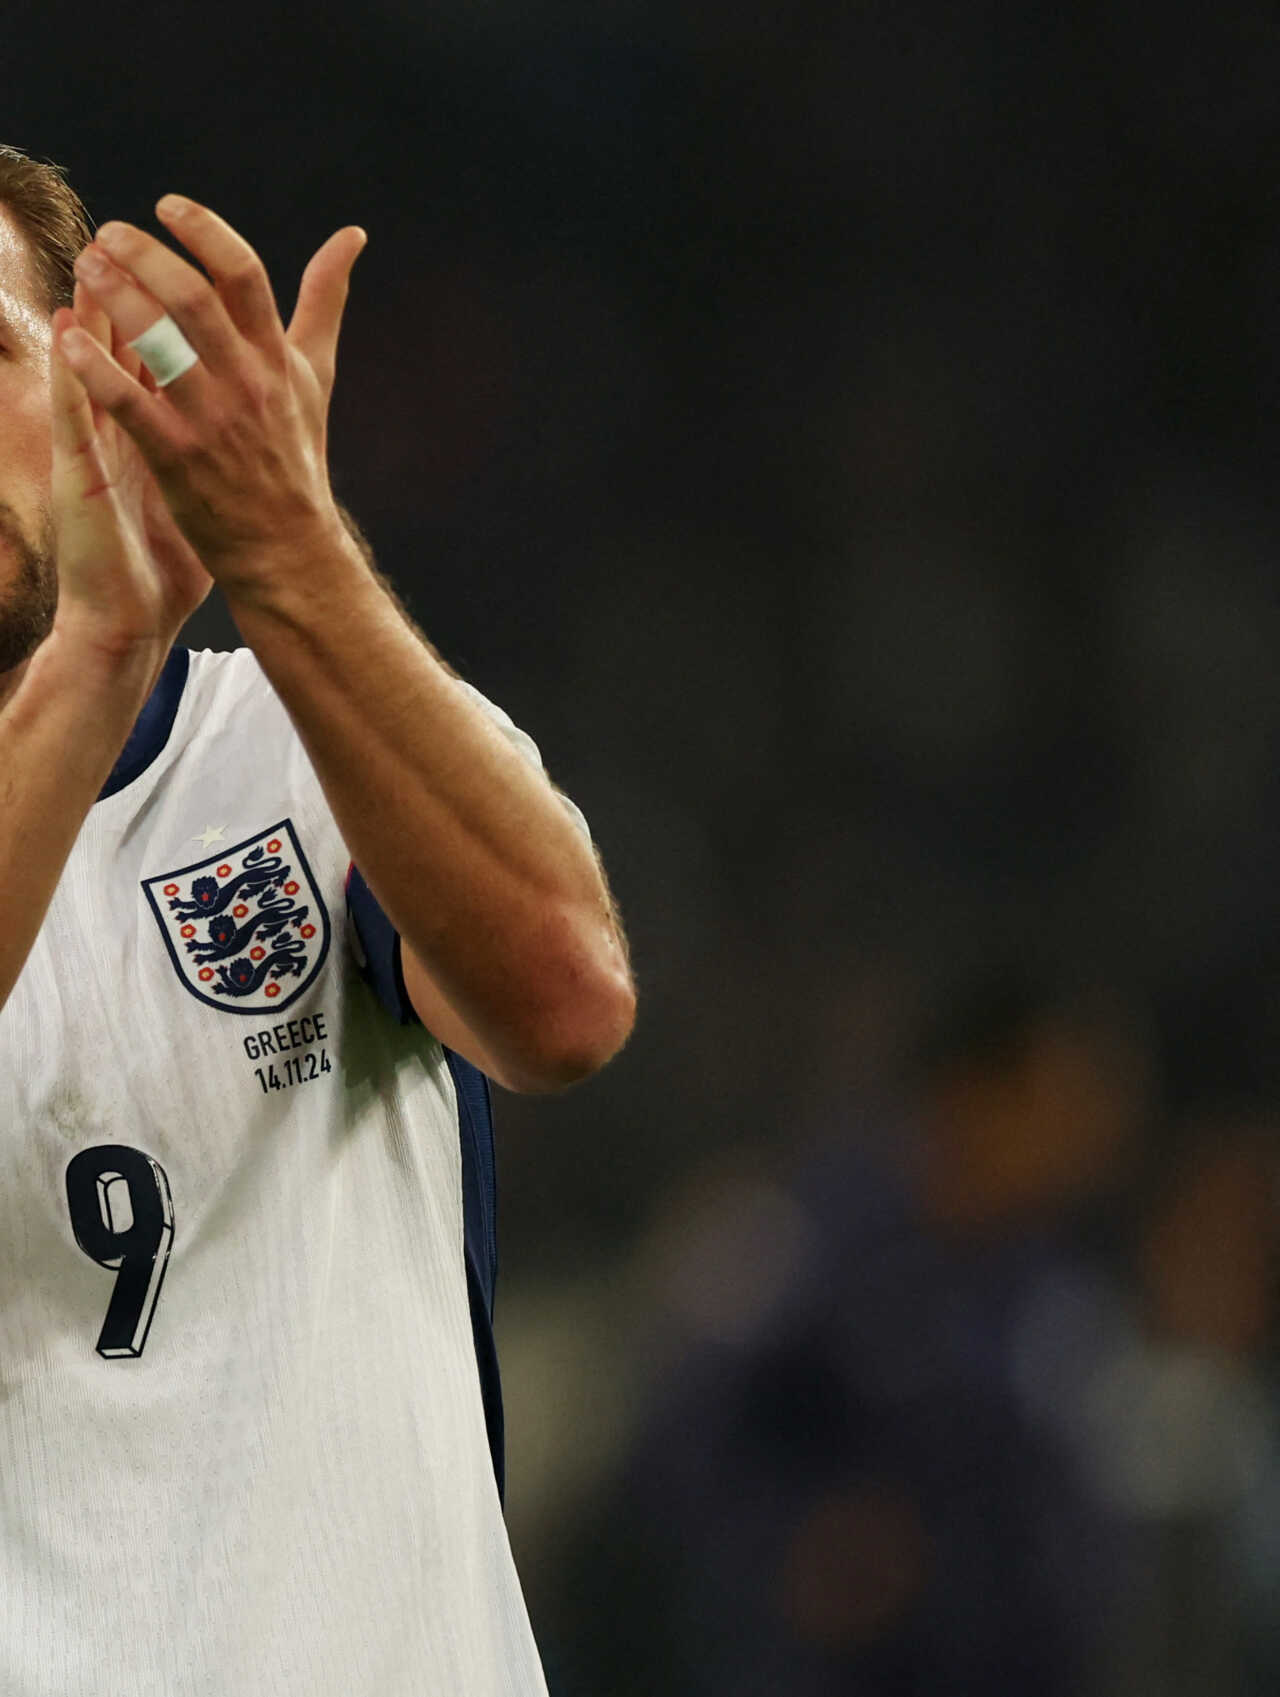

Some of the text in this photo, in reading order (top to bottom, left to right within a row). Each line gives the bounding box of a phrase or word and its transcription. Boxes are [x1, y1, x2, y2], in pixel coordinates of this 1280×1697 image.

[243, 1013, 328, 1060] GREECE
[254, 1048, 332, 1094] 14.11.24
[65, 1144, 175, 1360] 9
